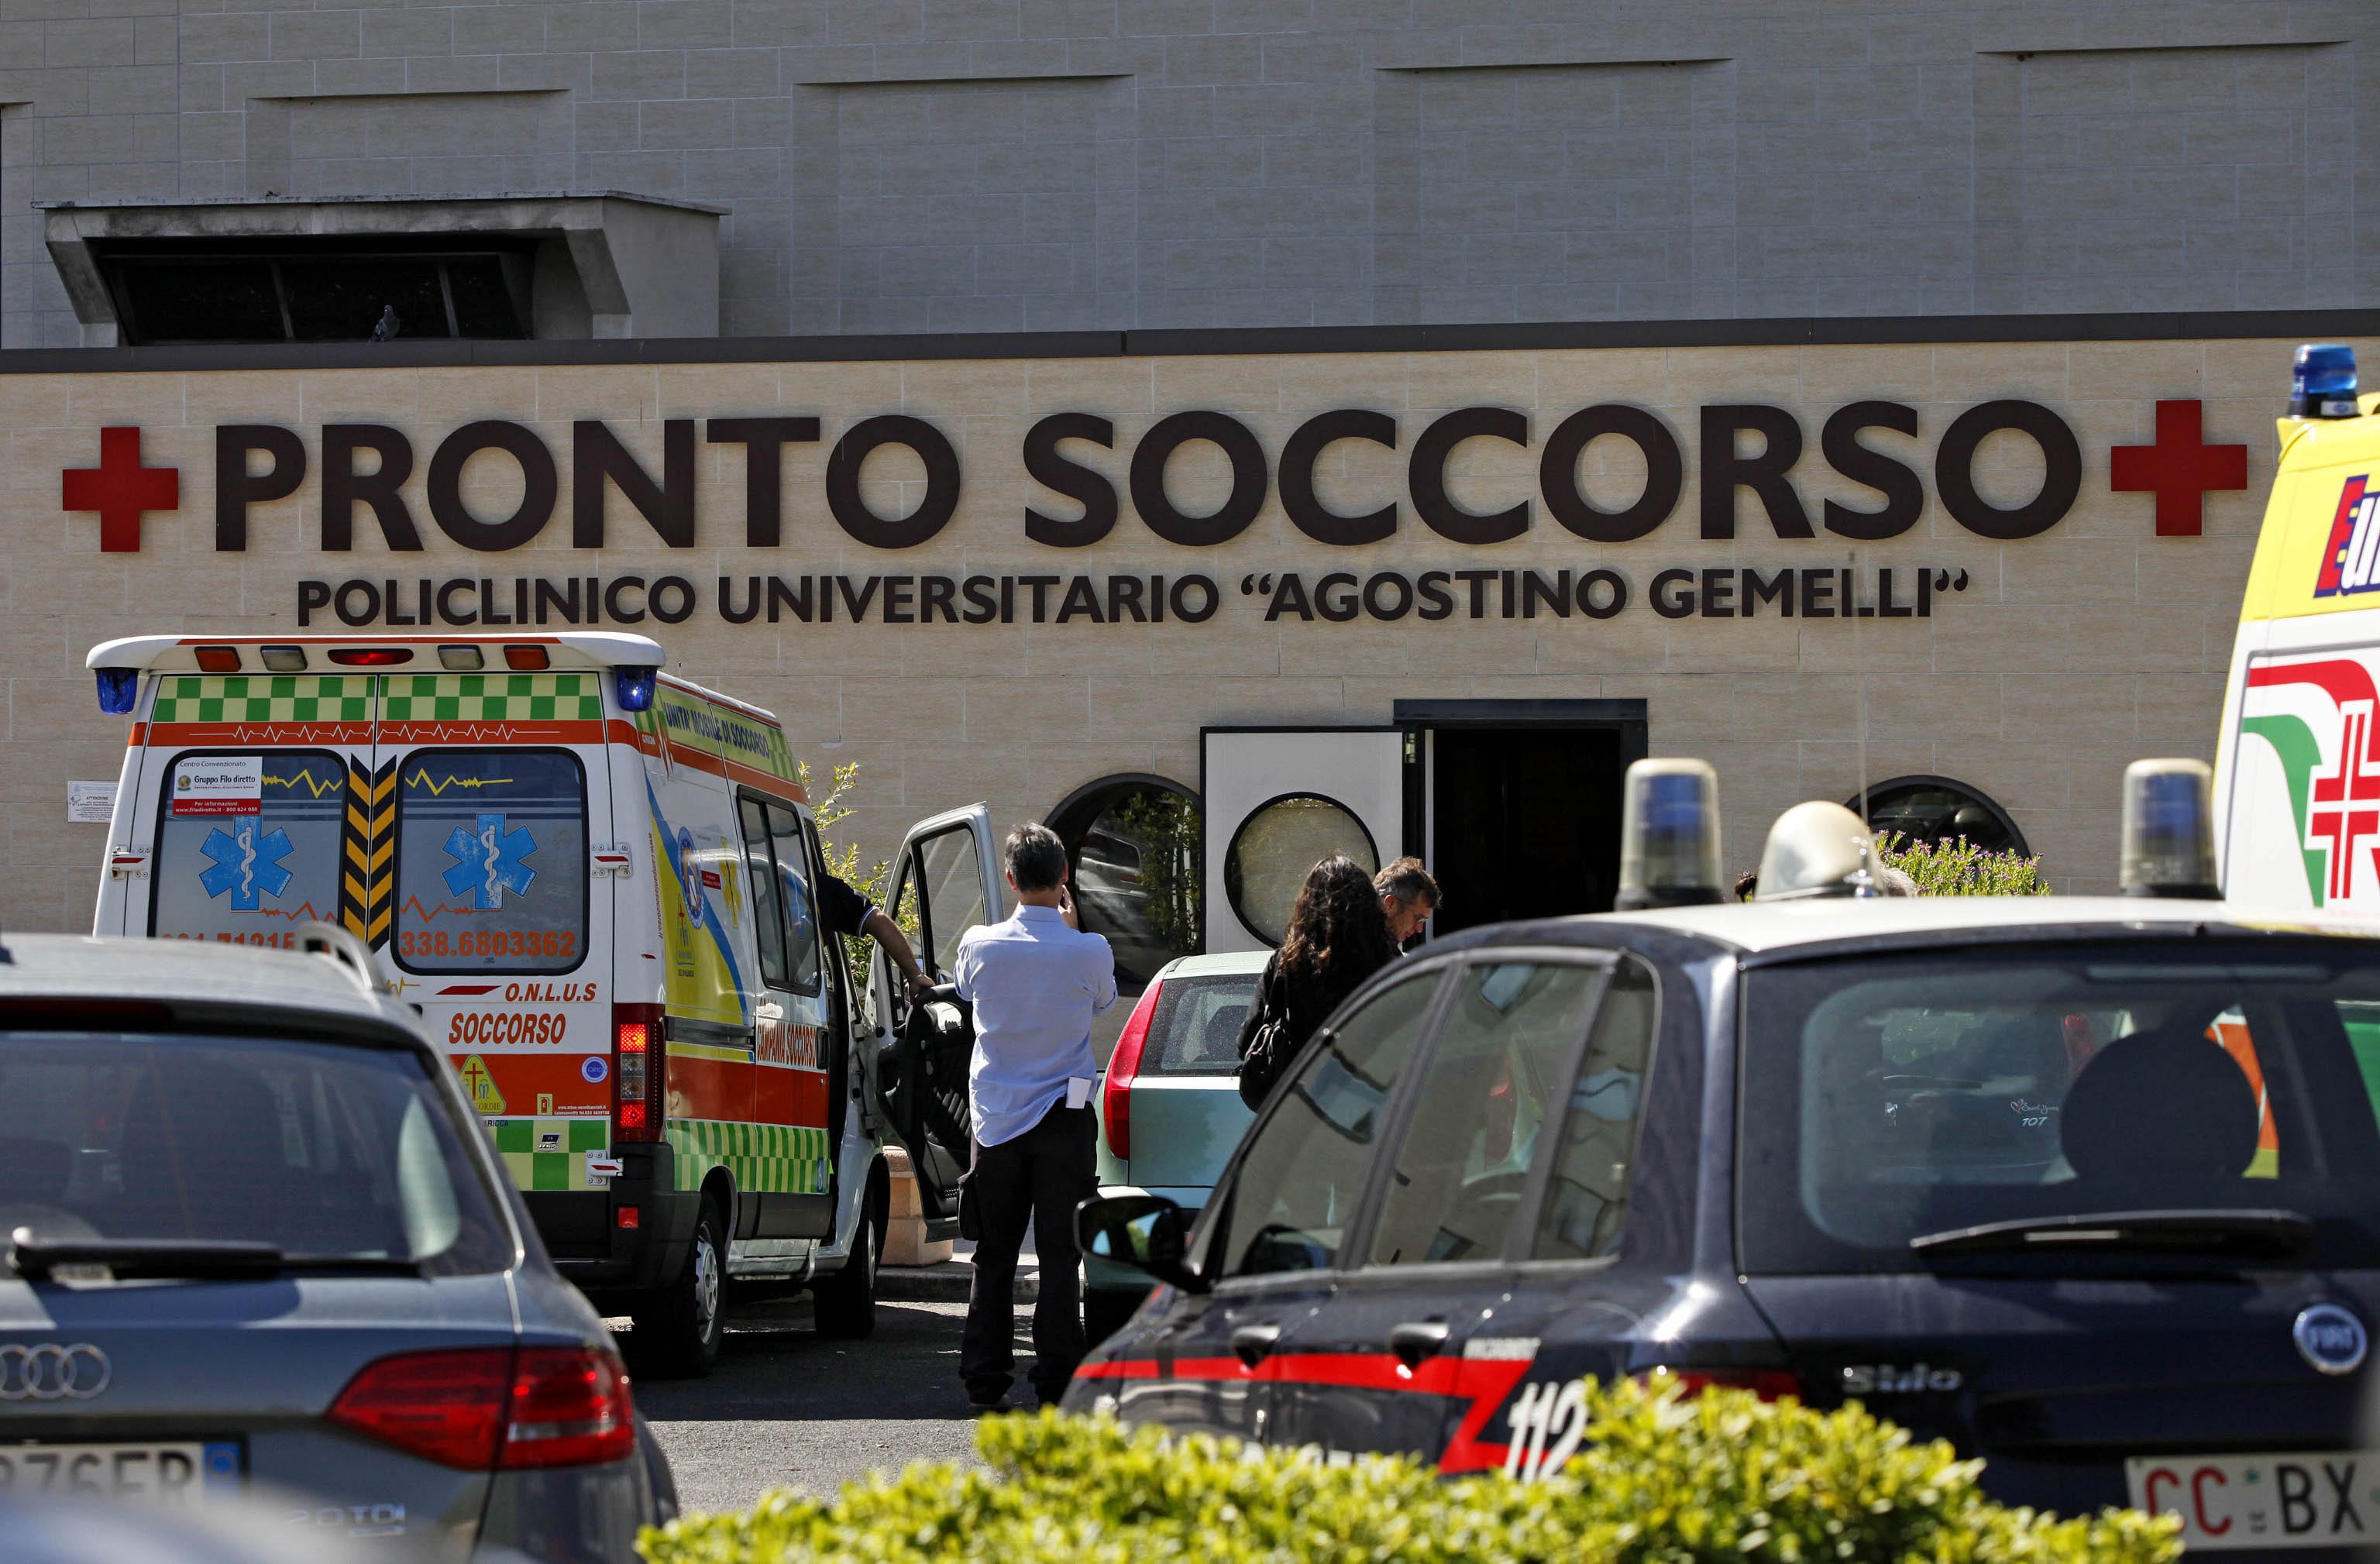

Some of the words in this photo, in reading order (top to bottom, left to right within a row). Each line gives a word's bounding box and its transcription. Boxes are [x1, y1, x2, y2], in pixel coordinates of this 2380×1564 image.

[216, 415, 961, 552] PRONTO
[1023, 397, 2082, 546] SOCCORSO
[298, 576, 696, 627] POLICLINICO
[718, 574, 1219, 624] UNIVERSITARIO
[1241, 569, 1627, 621] “AGOSTINO
[1649, 567, 1969, 619] GEMELLI”
[690, 710, 723, 741] MOBILE
[721, 720, 732, 745] DI
[731, 723, 769, 759] SOCCORSO
[194, 775, 218, 785] Gruppo
[233, 775, 256, 783] diretto
[401, 931, 575, 957] 338.6803362
[505, 983, 597, 1002] O.N.L.U.S
[449, 1012, 566, 1044] SOCCORSO
[758, 1021, 785, 1064] CAMPANIA
[786, 1022, 817, 1067] SOCCORSO
[2022, 1116, 2048, 1127] 107
[1505, 1379, 1588, 1487] 112
[2144, 1466, 2234, 1538] CC
[2275, 1460, 2366, 1535] BX
